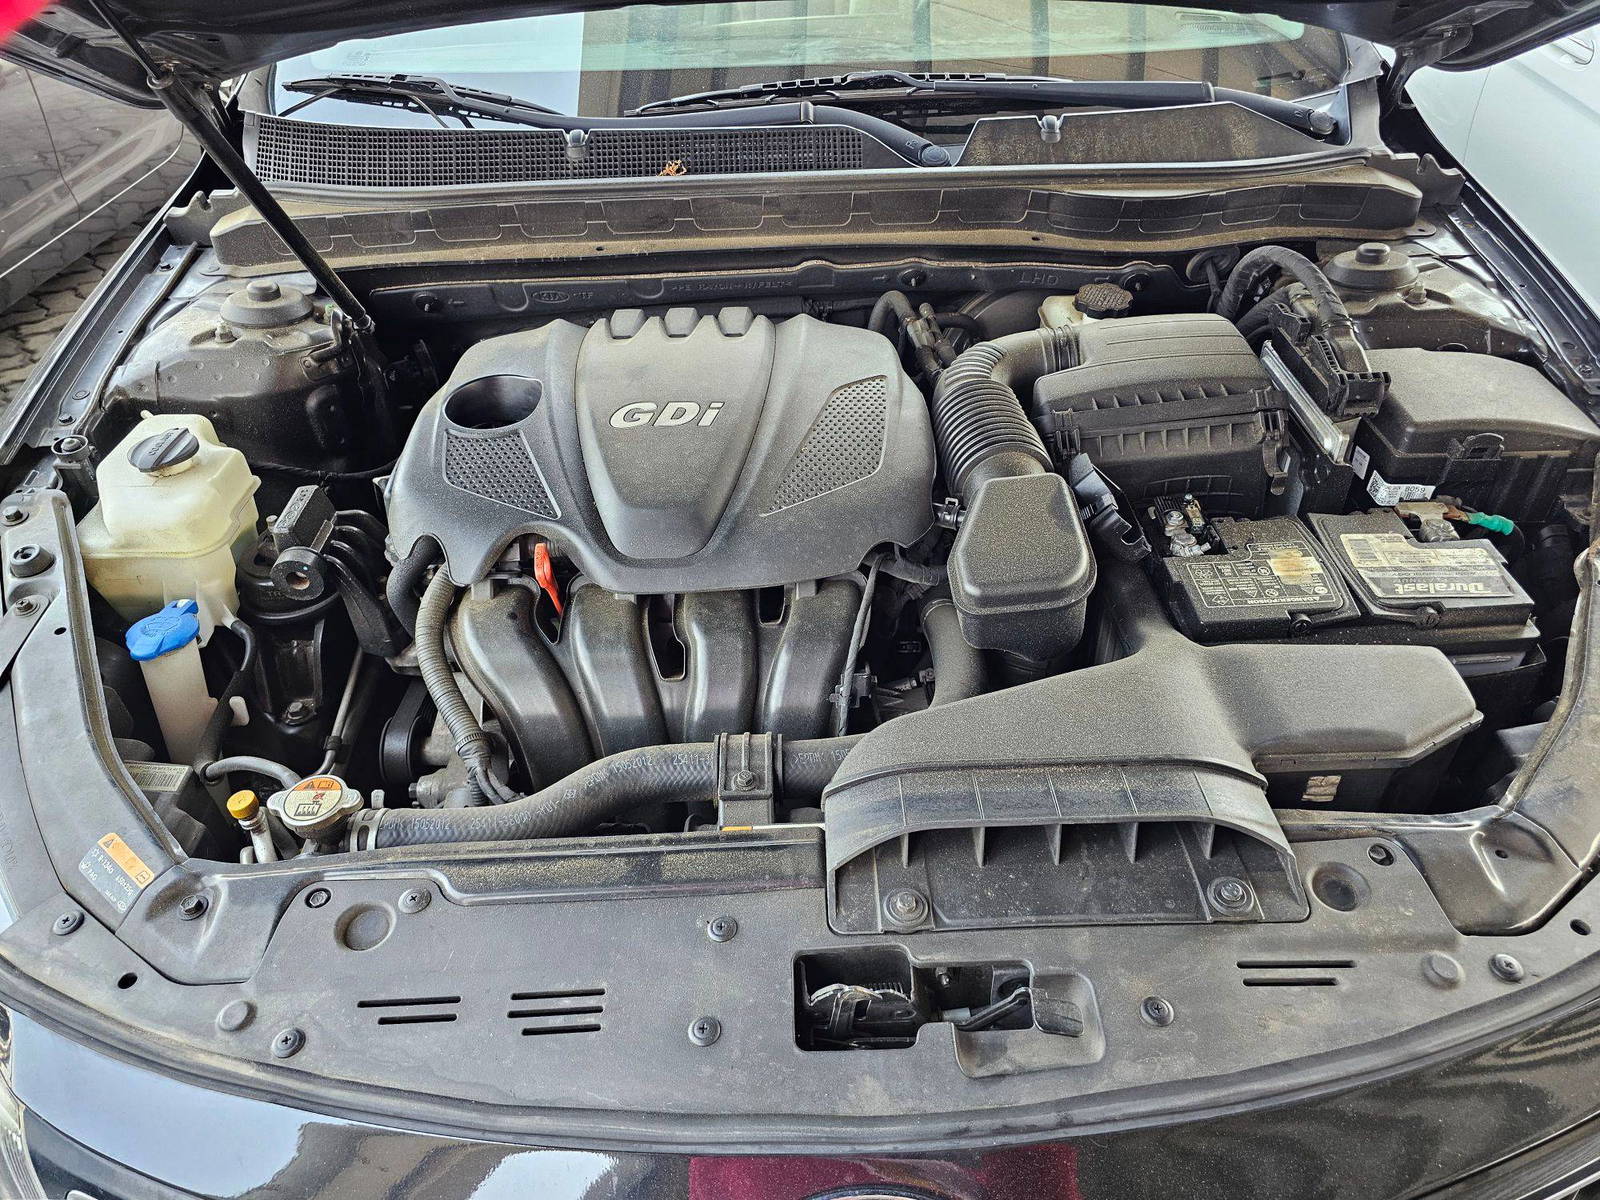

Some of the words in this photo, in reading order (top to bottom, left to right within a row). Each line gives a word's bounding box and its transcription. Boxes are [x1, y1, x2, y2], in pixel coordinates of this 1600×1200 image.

[609, 401, 725, 428] GDi
[1393, 582, 1491, 594] Duralast
[411, 817, 450, 830] 15052012
[612, 755, 653, 775] 15052012
